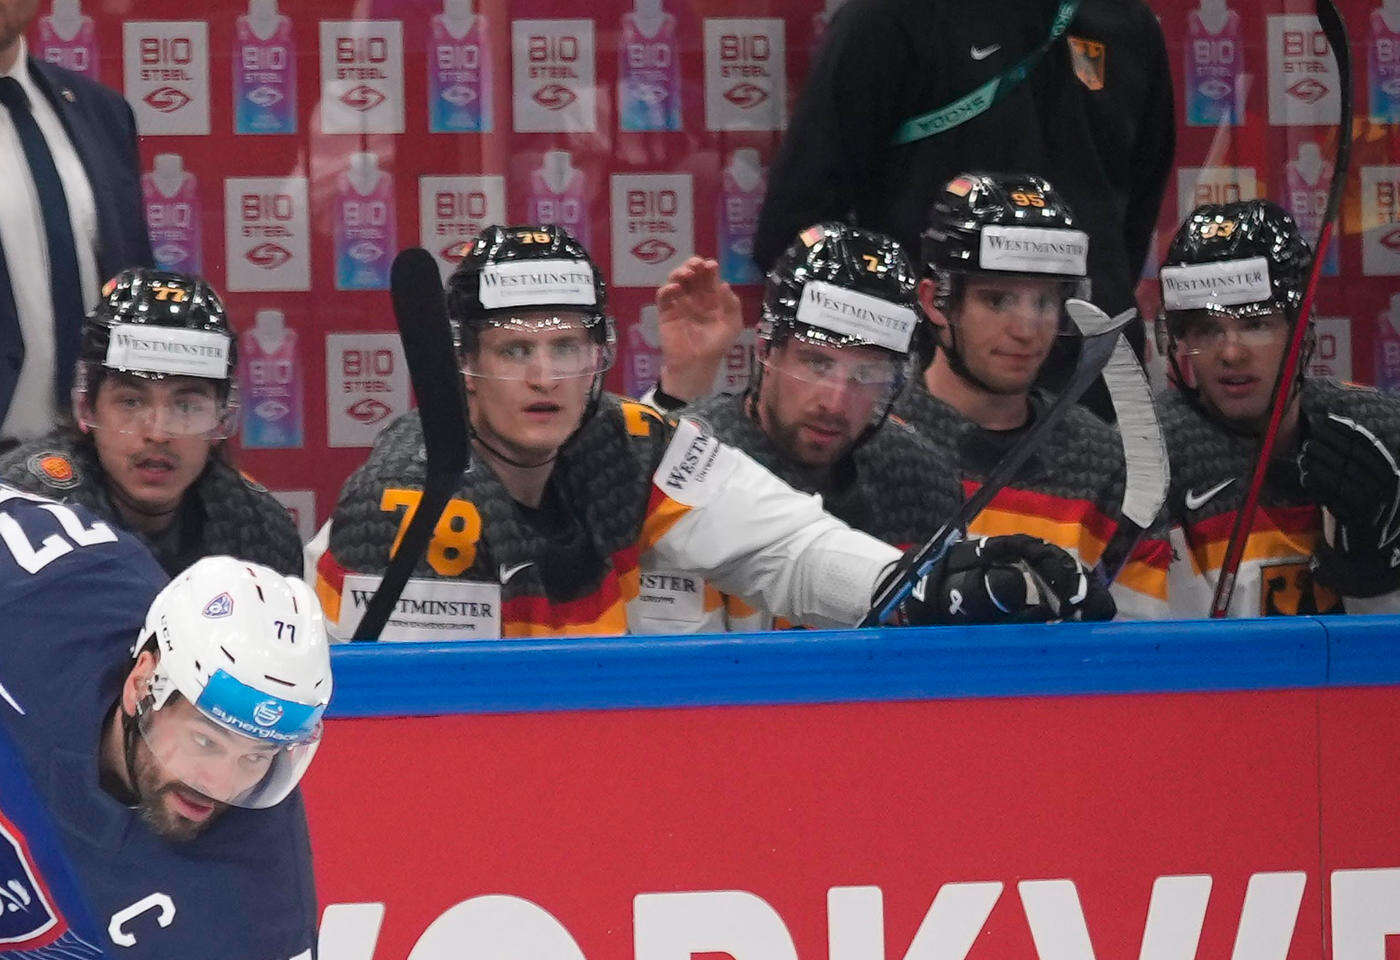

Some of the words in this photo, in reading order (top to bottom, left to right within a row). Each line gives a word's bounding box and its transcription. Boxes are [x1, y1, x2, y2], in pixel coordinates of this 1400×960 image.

[141, 38, 192, 65] BIO
[336, 38, 387, 64] BIO
[528, 36, 579, 61] BIO
[720, 35, 771, 61] BIO
[1283, 32, 1331, 57] BIO
[244, 47, 285, 70] BIO
[438, 46, 479, 69] BIO
[141, 69, 193, 81] STEEL
[337, 67, 388, 79] STEEL
[528, 66, 579, 78] STEEL
[720, 66, 771, 77] STEEL
[243, 195, 293, 220] BIO
[436, 192, 487, 219] BIO
[627, 191, 678, 217] BIO
[1012, 193, 1046, 207] 95
[243, 226, 294, 237] STEEL
[628, 221, 677, 233] STEEL
[988, 235, 1085, 256] WESTMINSTER
[863, 255, 879, 273] 7
[484, 272, 592, 285] WESTMINSTER
[1165, 271, 1262, 291] WESTMINSTER
[152, 286, 186, 302] 77
[807, 290, 909, 333] WESTMINSTER
[116, 333, 223, 358] WESTMINSTER
[344, 350, 394, 376] BIO
[344, 381, 392, 393] STEEL
[380, 488, 482, 576] 78
[352, 590, 493, 618] WTMINSTER
[274, 620, 296, 643] 77
[211, 707, 299, 741] synerglace
[108, 892, 177, 947] C
